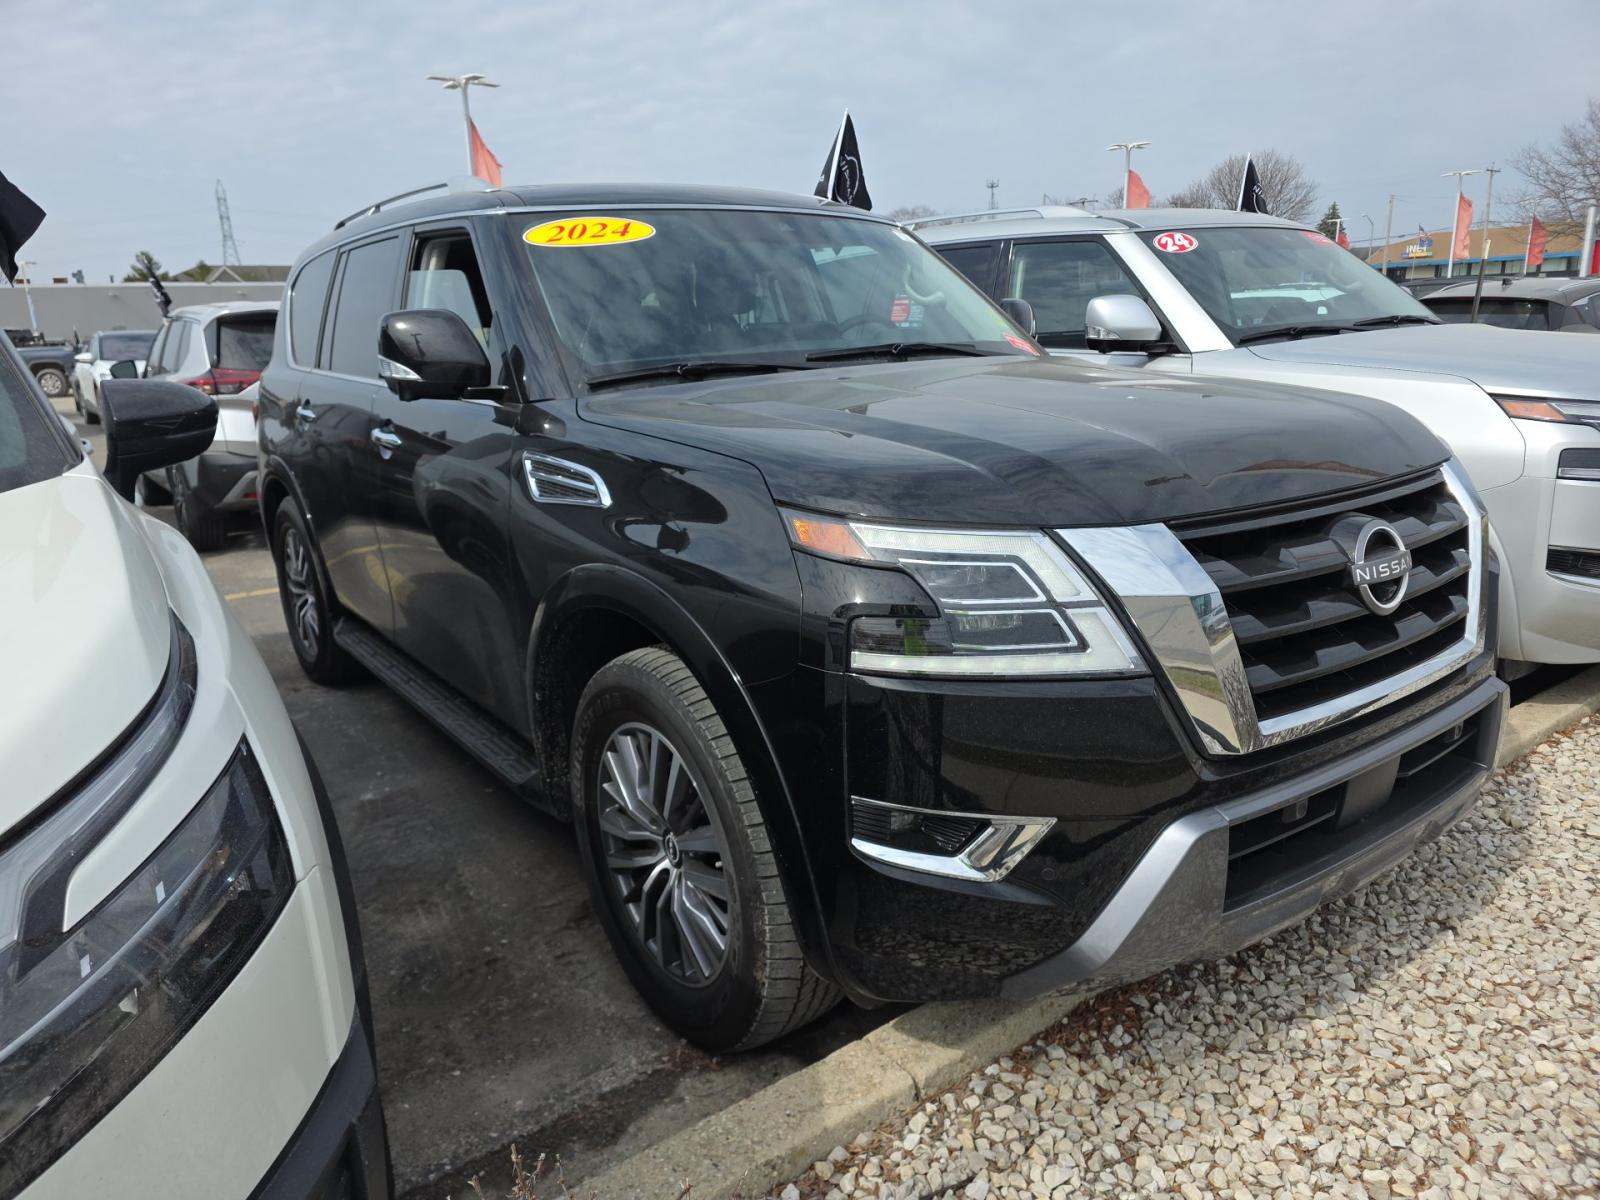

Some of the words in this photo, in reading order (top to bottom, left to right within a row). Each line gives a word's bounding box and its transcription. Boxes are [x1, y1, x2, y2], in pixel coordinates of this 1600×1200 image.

[545, 222, 632, 243] 2024
[1159, 232, 1193, 252] 24
[1356, 556, 1412, 582] NISSAN
